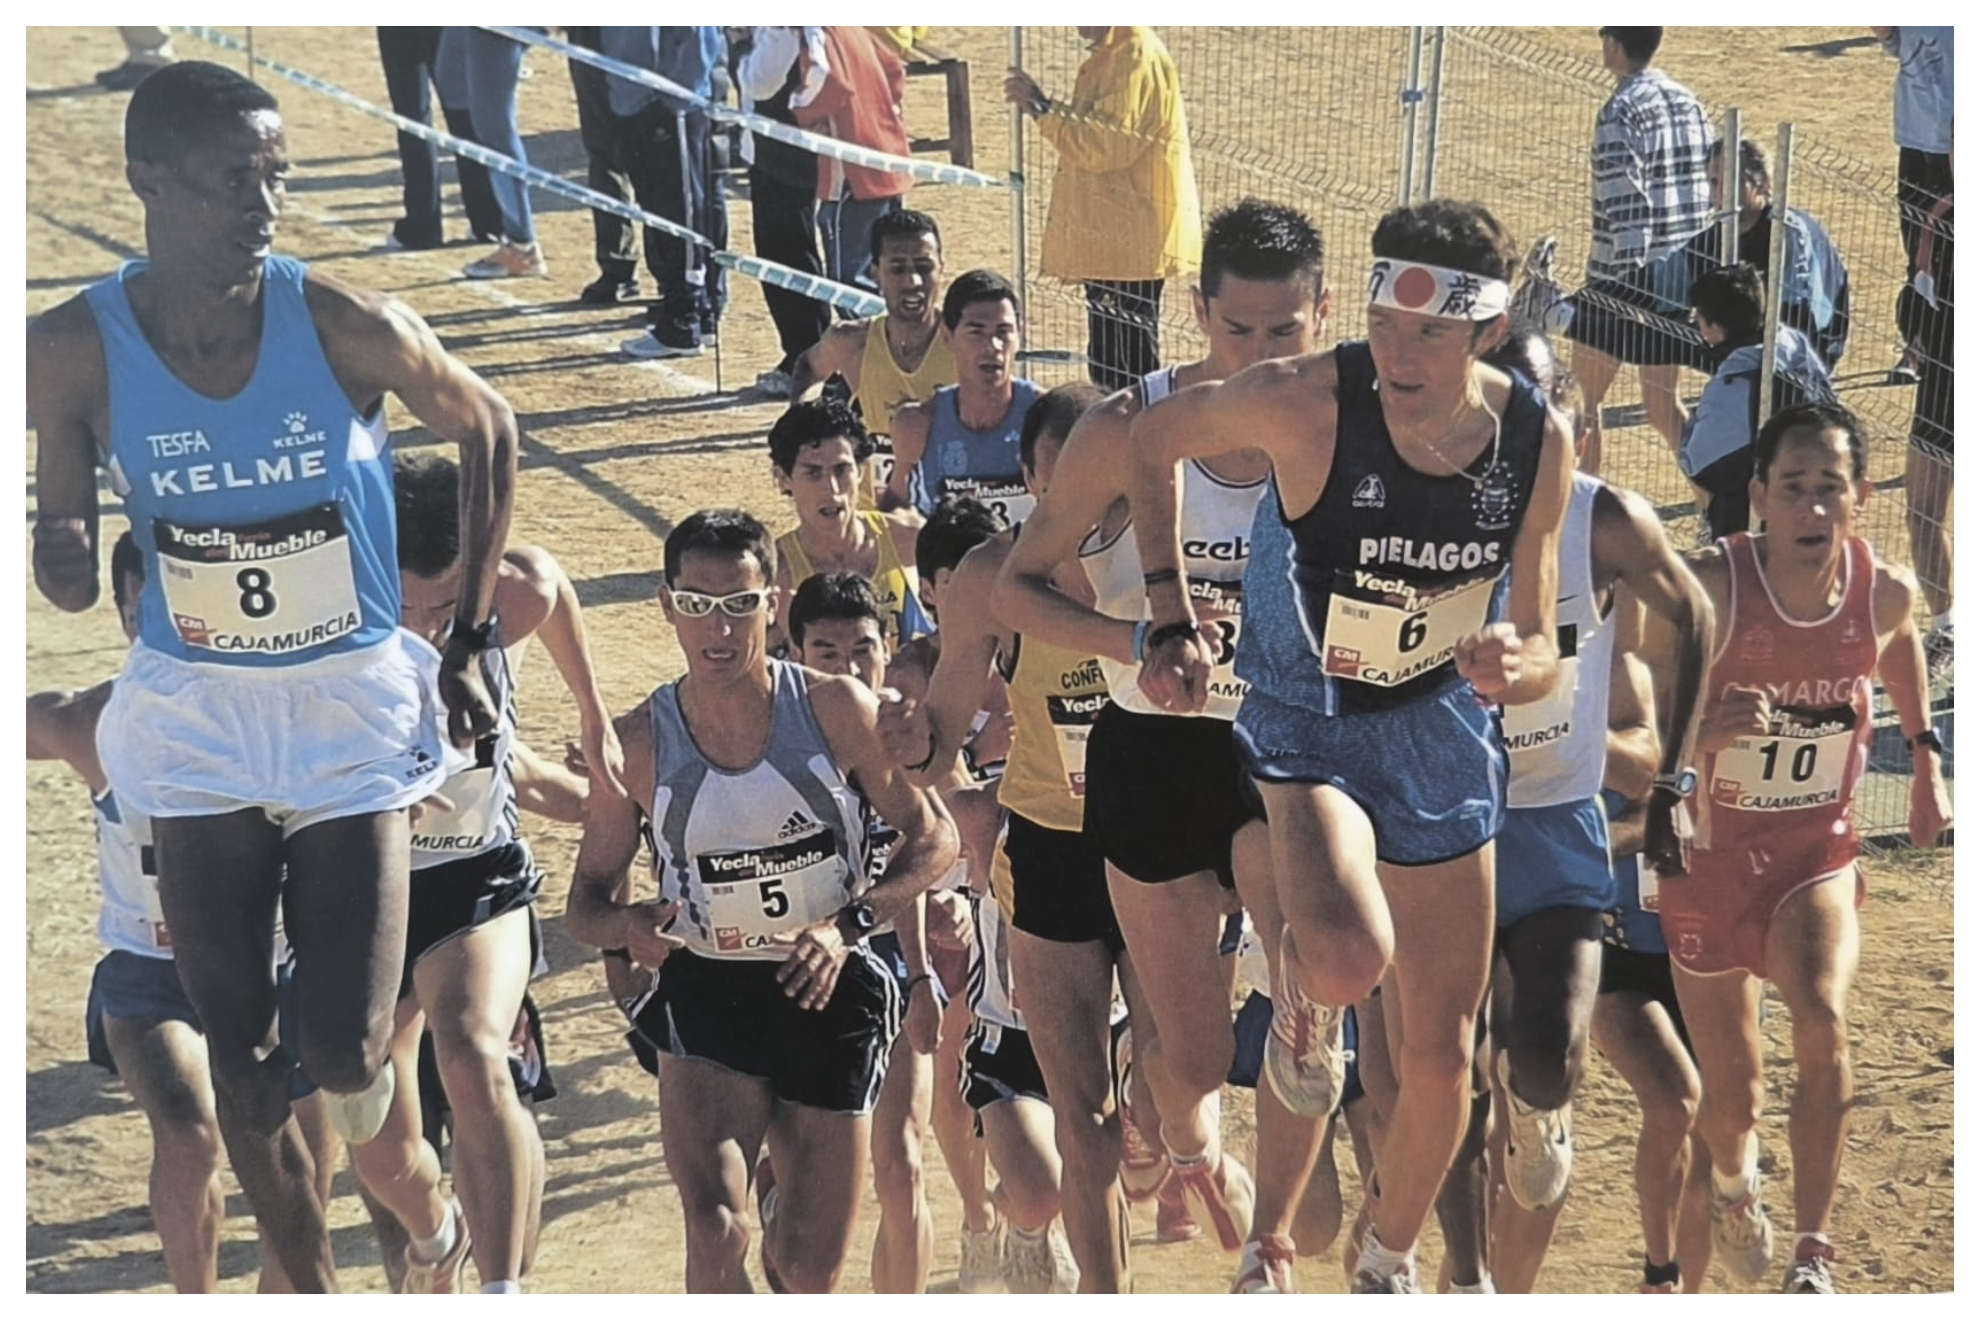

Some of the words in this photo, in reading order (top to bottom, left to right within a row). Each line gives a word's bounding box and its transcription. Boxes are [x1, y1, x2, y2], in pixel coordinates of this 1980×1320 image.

[146, 430, 211, 458] TESFA
[273, 431, 326, 449] KELME
[151, 449, 326, 497] KELME
[169, 525, 235, 547] Yecla
[229, 529, 326, 560] Mueble
[1359, 536, 1500, 572] PIELAGOS
[236, 567, 277, 619] 8
[1354, 570, 1416, 598] Yecla
[180, 617, 203, 630] CM
[214, 611, 358, 651] CAJAMURCIA
[1399, 611, 1428, 653] 6
[1334, 649, 1358, 661] CM
[1779, 720, 1846, 738] Mueble
[1759, 740, 1818, 783] 10
[1739, 789, 1838, 809] CAJAMURCIA
[710, 853, 760, 872] Yecla
[755, 851, 823, 877] Mueble
[759, 878, 789, 919] 5
